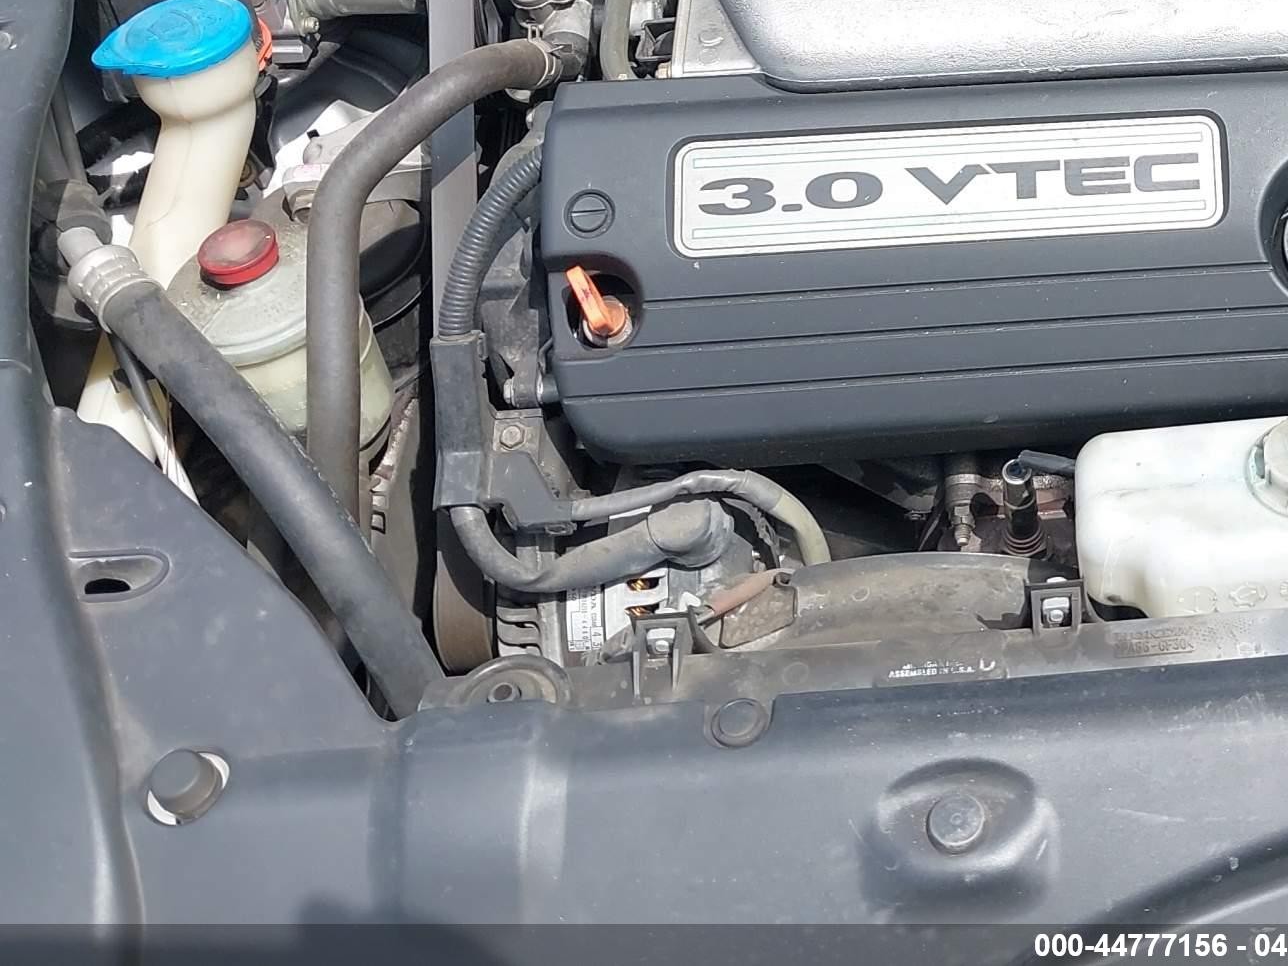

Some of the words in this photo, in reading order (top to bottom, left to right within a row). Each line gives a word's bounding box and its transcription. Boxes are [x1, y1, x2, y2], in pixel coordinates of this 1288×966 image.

[700, 171, 884, 216] 3.0
[904, 152, 1200, 205] VTEC
[888, 668, 938, 679] ASSEMBLED
